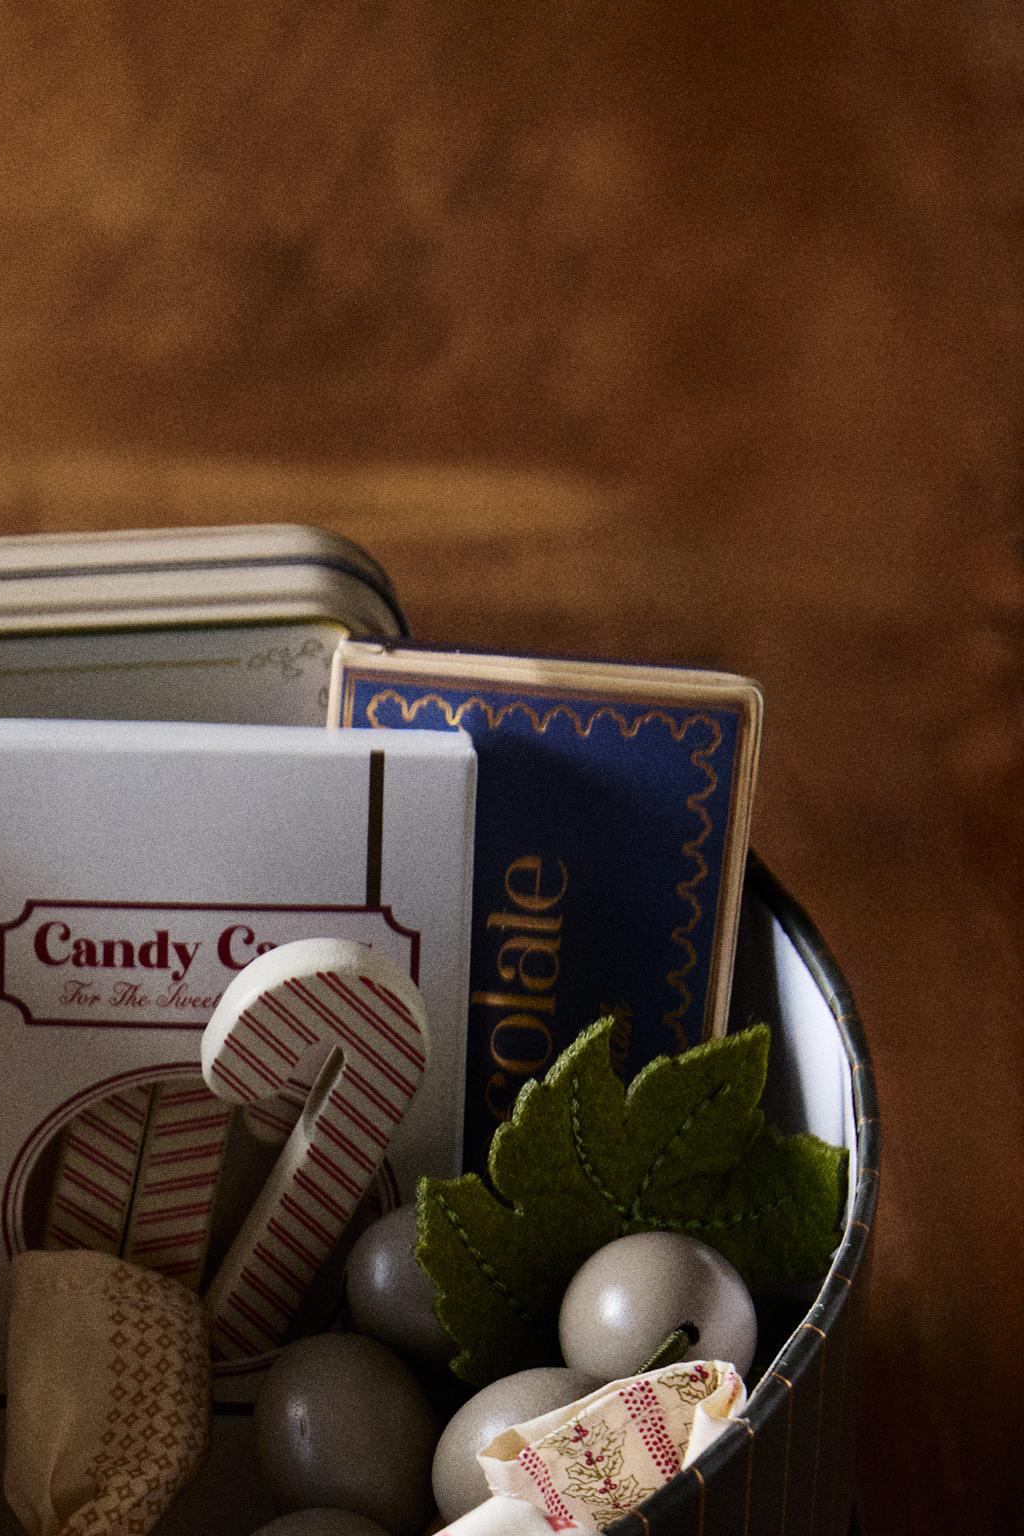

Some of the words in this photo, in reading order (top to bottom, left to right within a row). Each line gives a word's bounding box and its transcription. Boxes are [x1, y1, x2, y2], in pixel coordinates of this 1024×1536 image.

[33, 920, 201, 980] Candy
[60, 979, 102, 1006] For
[107, 980, 149, 1009] The
